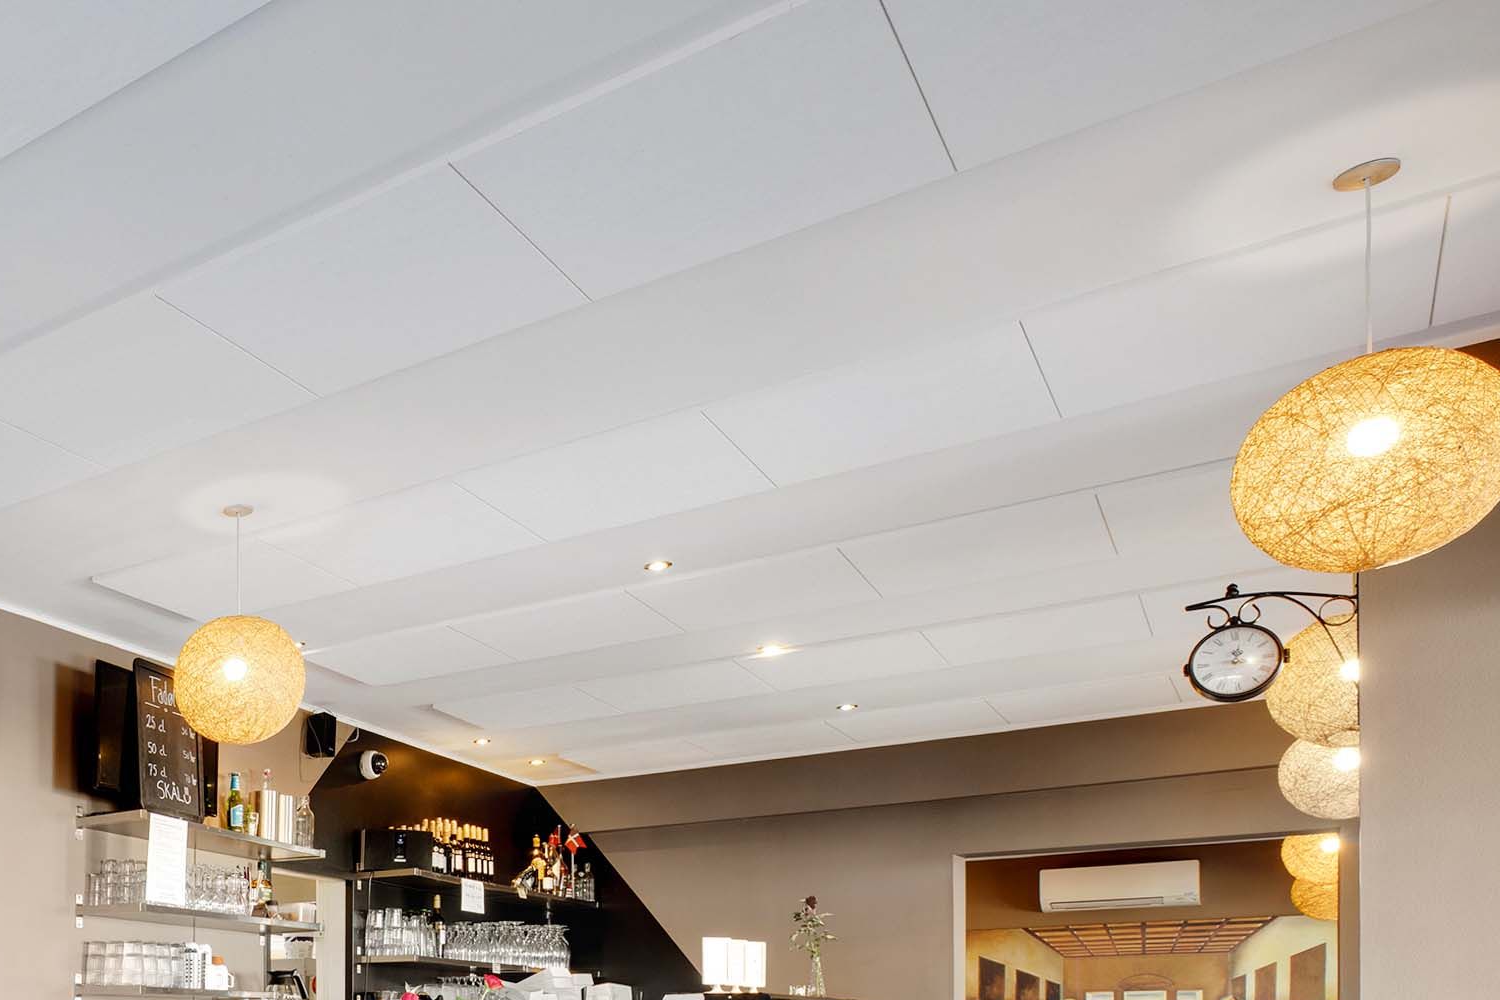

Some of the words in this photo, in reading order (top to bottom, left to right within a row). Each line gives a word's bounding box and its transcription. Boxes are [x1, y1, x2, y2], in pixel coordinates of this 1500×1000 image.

[146, 713, 156, 730] 25
[147, 741, 157, 754] 50
[148, 763, 157, 777] 75
